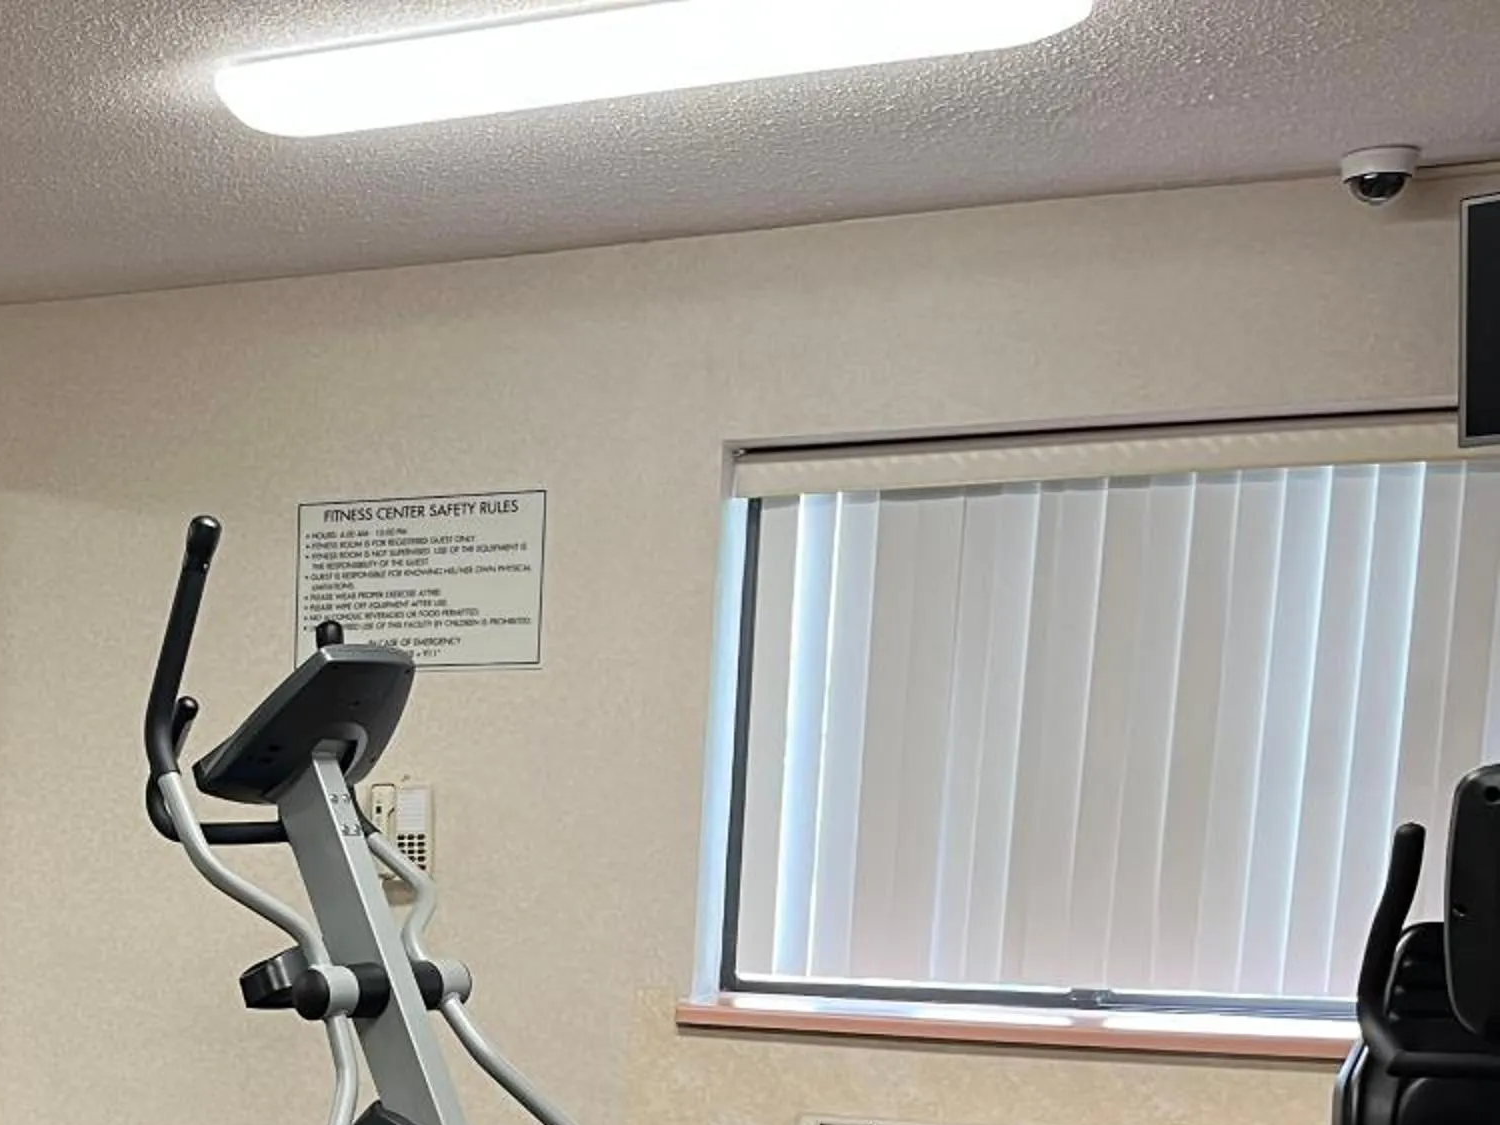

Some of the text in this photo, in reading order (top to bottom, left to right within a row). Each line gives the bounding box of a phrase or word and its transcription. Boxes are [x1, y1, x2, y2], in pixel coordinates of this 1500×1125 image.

[323, 500, 520, 523] FITNESS CENTER SAFETY RULES
